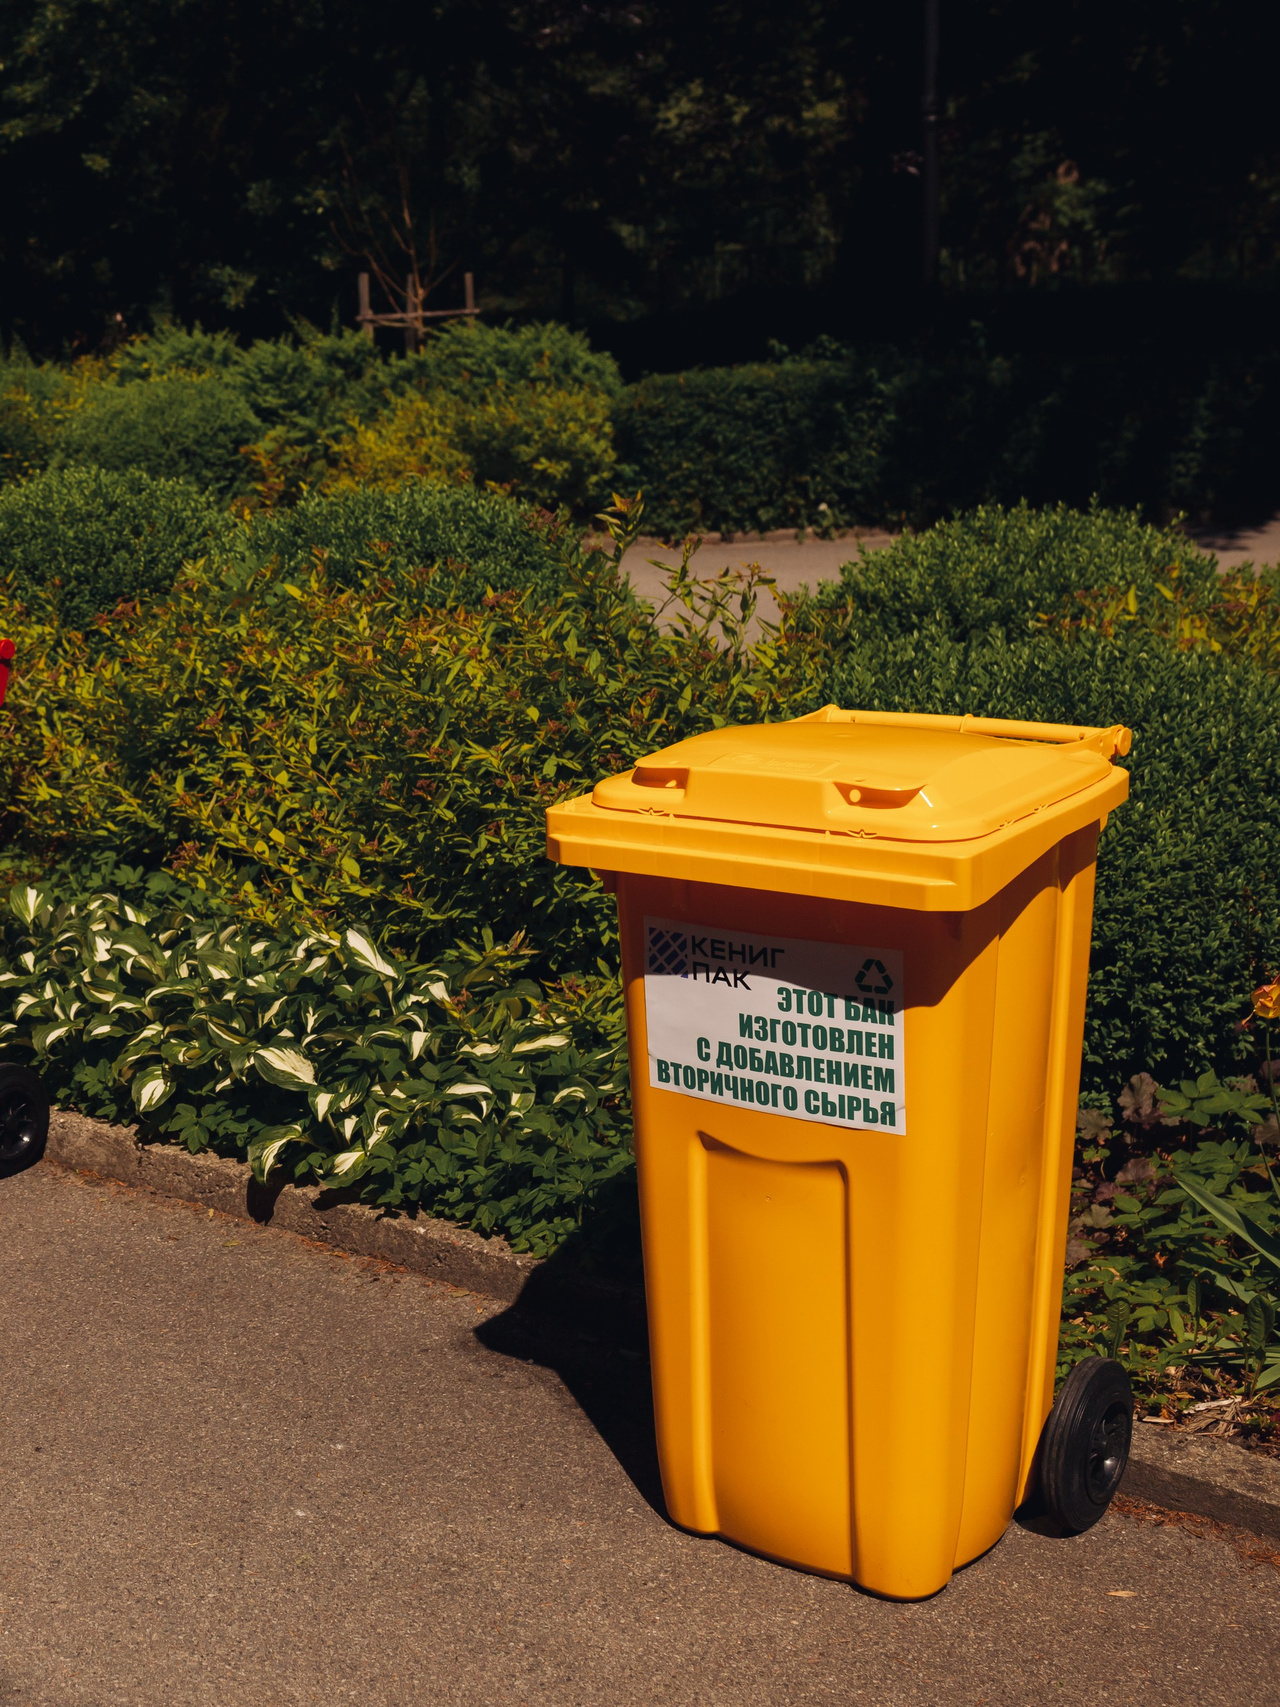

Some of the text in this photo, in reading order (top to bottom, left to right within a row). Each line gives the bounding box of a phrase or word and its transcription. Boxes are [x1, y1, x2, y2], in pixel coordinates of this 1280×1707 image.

[692, 935, 784, 968] КЕНИГ
[693, 961, 752, 991] ПАК
[777, 987, 895, 1026] ЭТОТ БАК
[739, 1013, 894, 1060] ИЗГОТОВЛЕН
[697, 1037, 895, 1093] С ДОБАВЛЕНИЕМ
[657, 1059, 896, 1127] ВТОРИЧНОГО СЫРЬЯ
